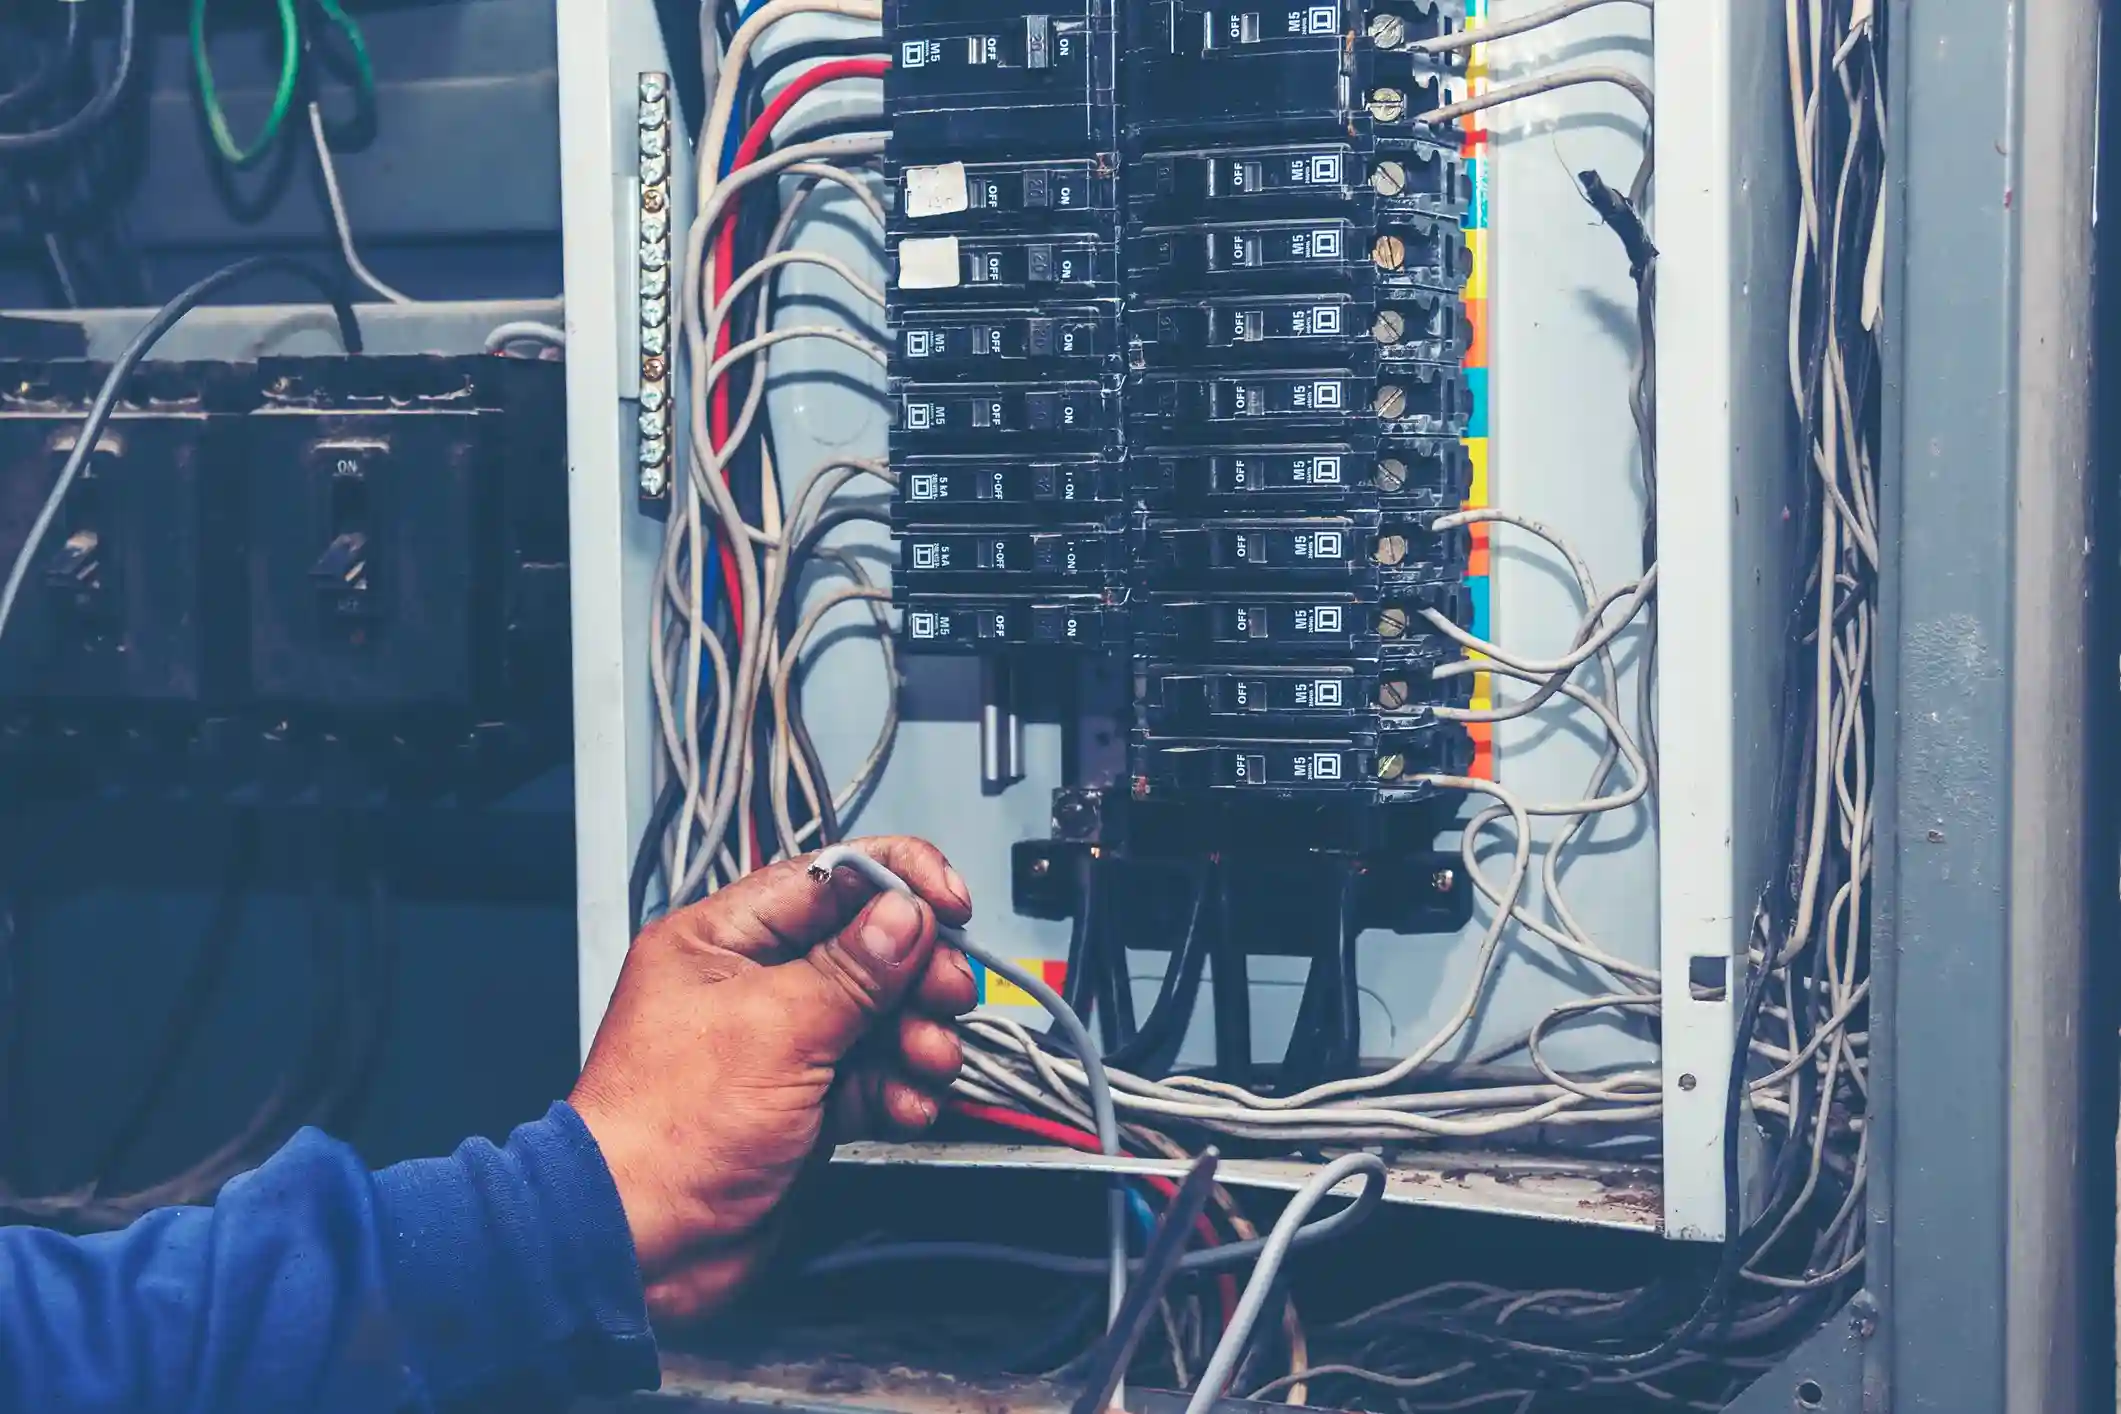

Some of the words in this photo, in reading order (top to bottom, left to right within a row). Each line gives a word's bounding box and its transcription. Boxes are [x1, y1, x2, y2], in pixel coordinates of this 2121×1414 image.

[1230, 14, 1240, 38] OFF
[1287, 11, 1300, 32] M5
[930, 42, 940, 62] M5
[987, 38, 997, 61] OFF
[1060, 39, 1069, 57] ON
[1233, 162, 1243, 186] OFF
[1291, 160, 1303, 181] M5
[988, 185, 997, 208] OFF
[1061, 187, 1070, 205] ON
[1233, 236, 1243, 259] OFF
[1292, 234, 1304, 255] M5
[989, 257, 998, 281] OFF
[1062, 260, 1071, 278] ON
[1234, 311, 1244, 335] OFF
[1293, 310, 1305, 334] M5
[935, 334, 945, 353] M5
[991, 330, 1001, 353] OFF
[1064, 334, 1073, 352] ON
[1235, 386, 1245, 409] OFF
[1293, 385, 1305, 406] M5
[935, 406, 945, 425] M5
[992, 403, 1001, 426] OFF
[1064, 406, 1073, 425] ON
[337, 460, 358, 473] ON
[1235, 459, 1245, 483] OFF
[1293, 460, 1305, 481] M5
[939, 476, 948, 485] 5
[1065, 484, 1074, 500] ON
[940, 545, 949, 554] 5
[1236, 535, 1246, 558] OFF
[1294, 535, 1307, 556] M5
[1066, 553, 1075, 569] ON
[939, 616, 949, 635] M5
[995, 615, 1005, 637] OFF
[1067, 618, 1076, 637] ON
[1237, 608, 1247, 631] OFF
[1295, 609, 1307, 630] M5
[1238, 682, 1247, 705] OFF
[1295, 683, 1307, 704] M5
[1236, 754, 1246, 777] OFF
[1294, 756, 1306, 777] M5
